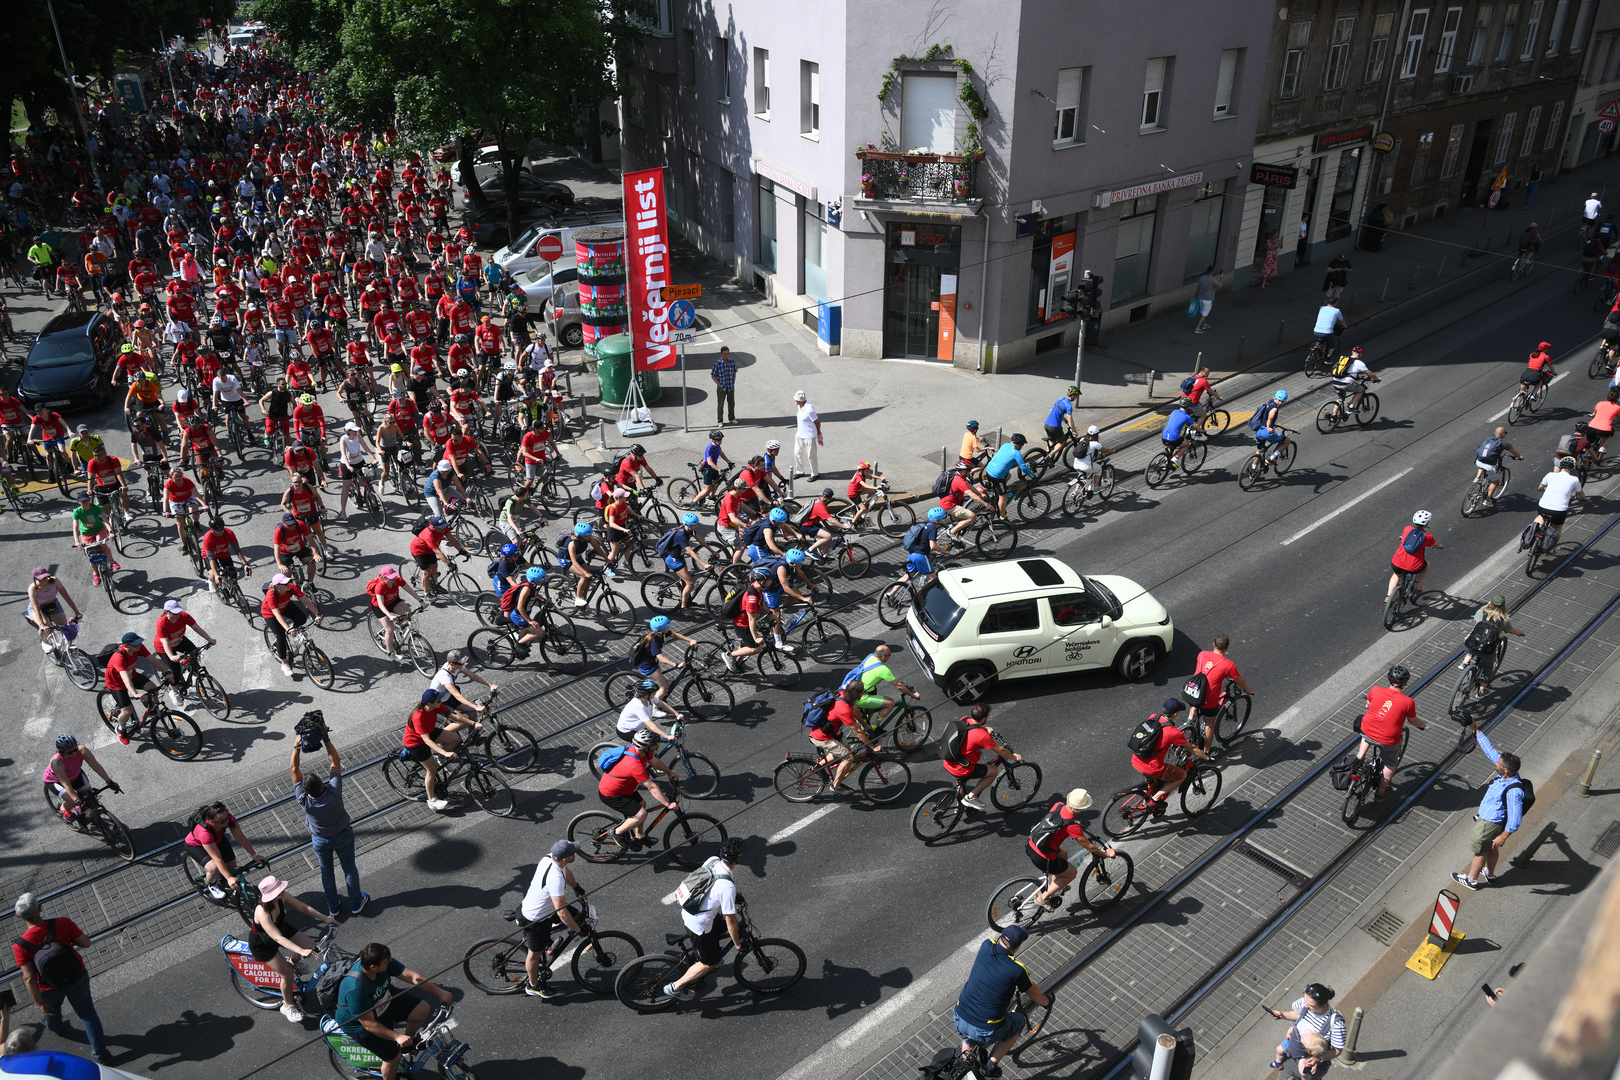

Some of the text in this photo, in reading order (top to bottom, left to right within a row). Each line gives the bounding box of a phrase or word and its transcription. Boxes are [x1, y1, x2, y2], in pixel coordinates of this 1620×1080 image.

[1600, 121, 1612, 131] 40
[1322, 135, 1337, 145] CITY
[1337, 132, 1352, 142] CLUB
[1353, 128, 1370, 138] GRILL
[757, 163, 811, 198] PRIVREDNA BANKA ZAGREB
[1255, 171, 1292, 186] PARIS
[1111, 173, 1202, 202] PRIVREDNA BANKA ZAGREB
[920, 233, 944, 246] PBZ
[634, 177, 671, 366] Večernji list
[669, 285, 699, 298] Pješaci
[1065, 639, 1100, 648] Večernjakova
[1006, 658, 1042, 667] HYUNDAI
[244, 969, 280, 978] CALORIES
